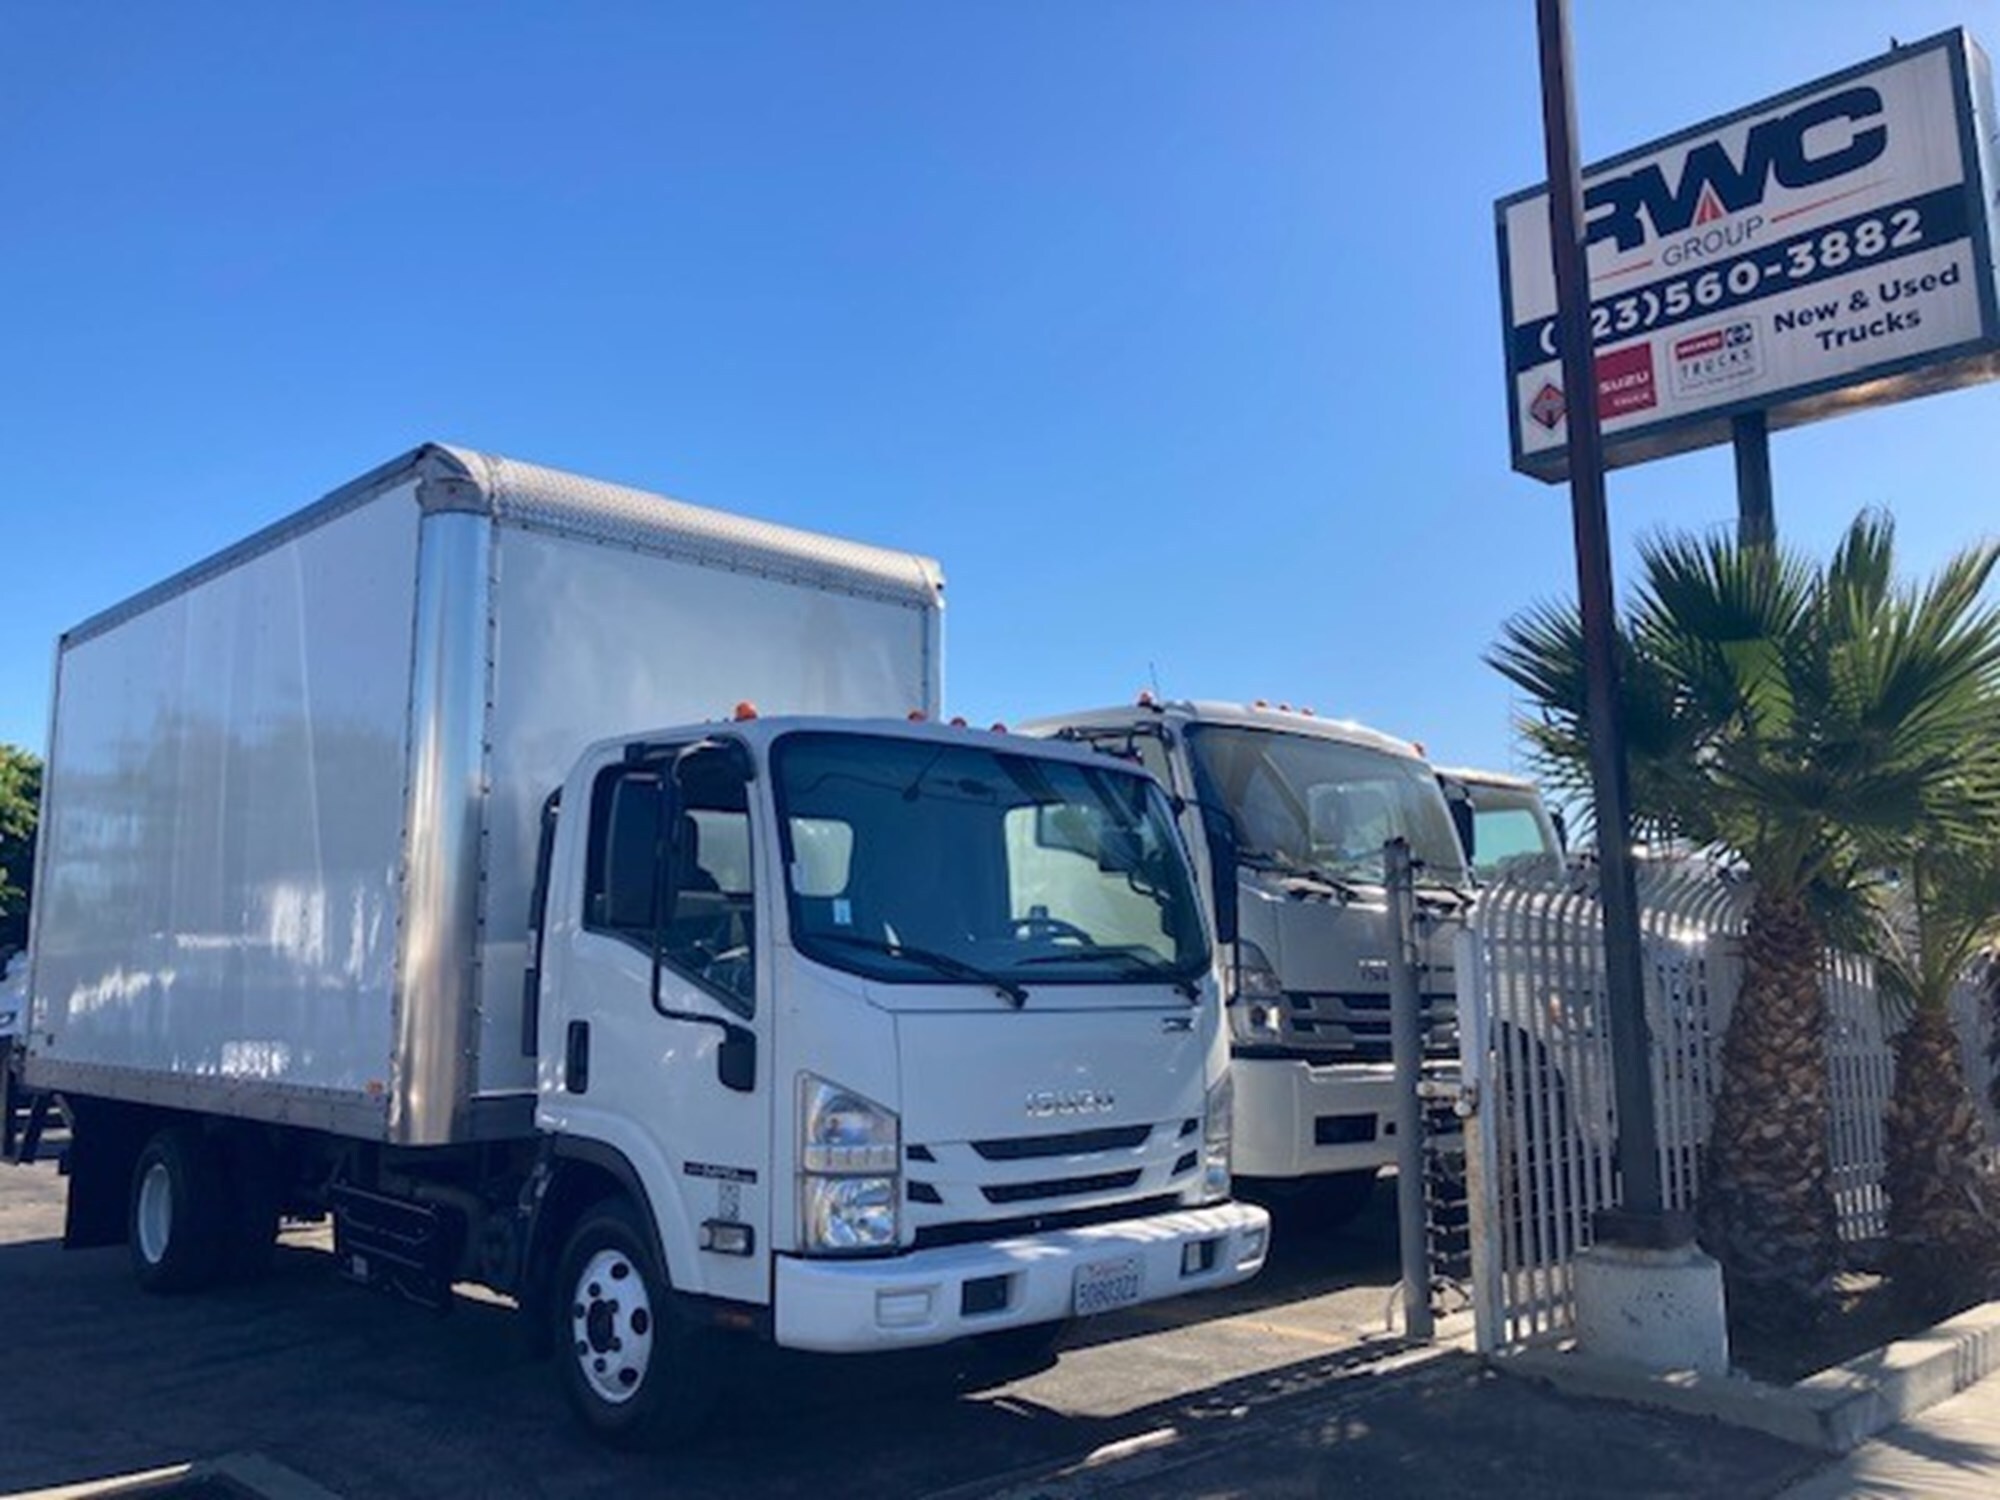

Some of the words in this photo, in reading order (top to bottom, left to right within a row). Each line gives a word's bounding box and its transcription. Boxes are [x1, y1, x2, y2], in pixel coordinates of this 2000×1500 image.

[1582, 86, 1888, 255] RWC
[1660, 215, 1764, 268] GROUP
[1540, 208, 1923, 355] (23)560-3882
[1773, 301, 1841, 334] New
[1849, 289, 1870, 312] &
[1879, 262, 1961, 301] Used
[1815, 307, 1922, 353] Trucks
[1599, 371, 1650, 395] SUZU
[1026, 1090, 1114, 1117] ISUZU
